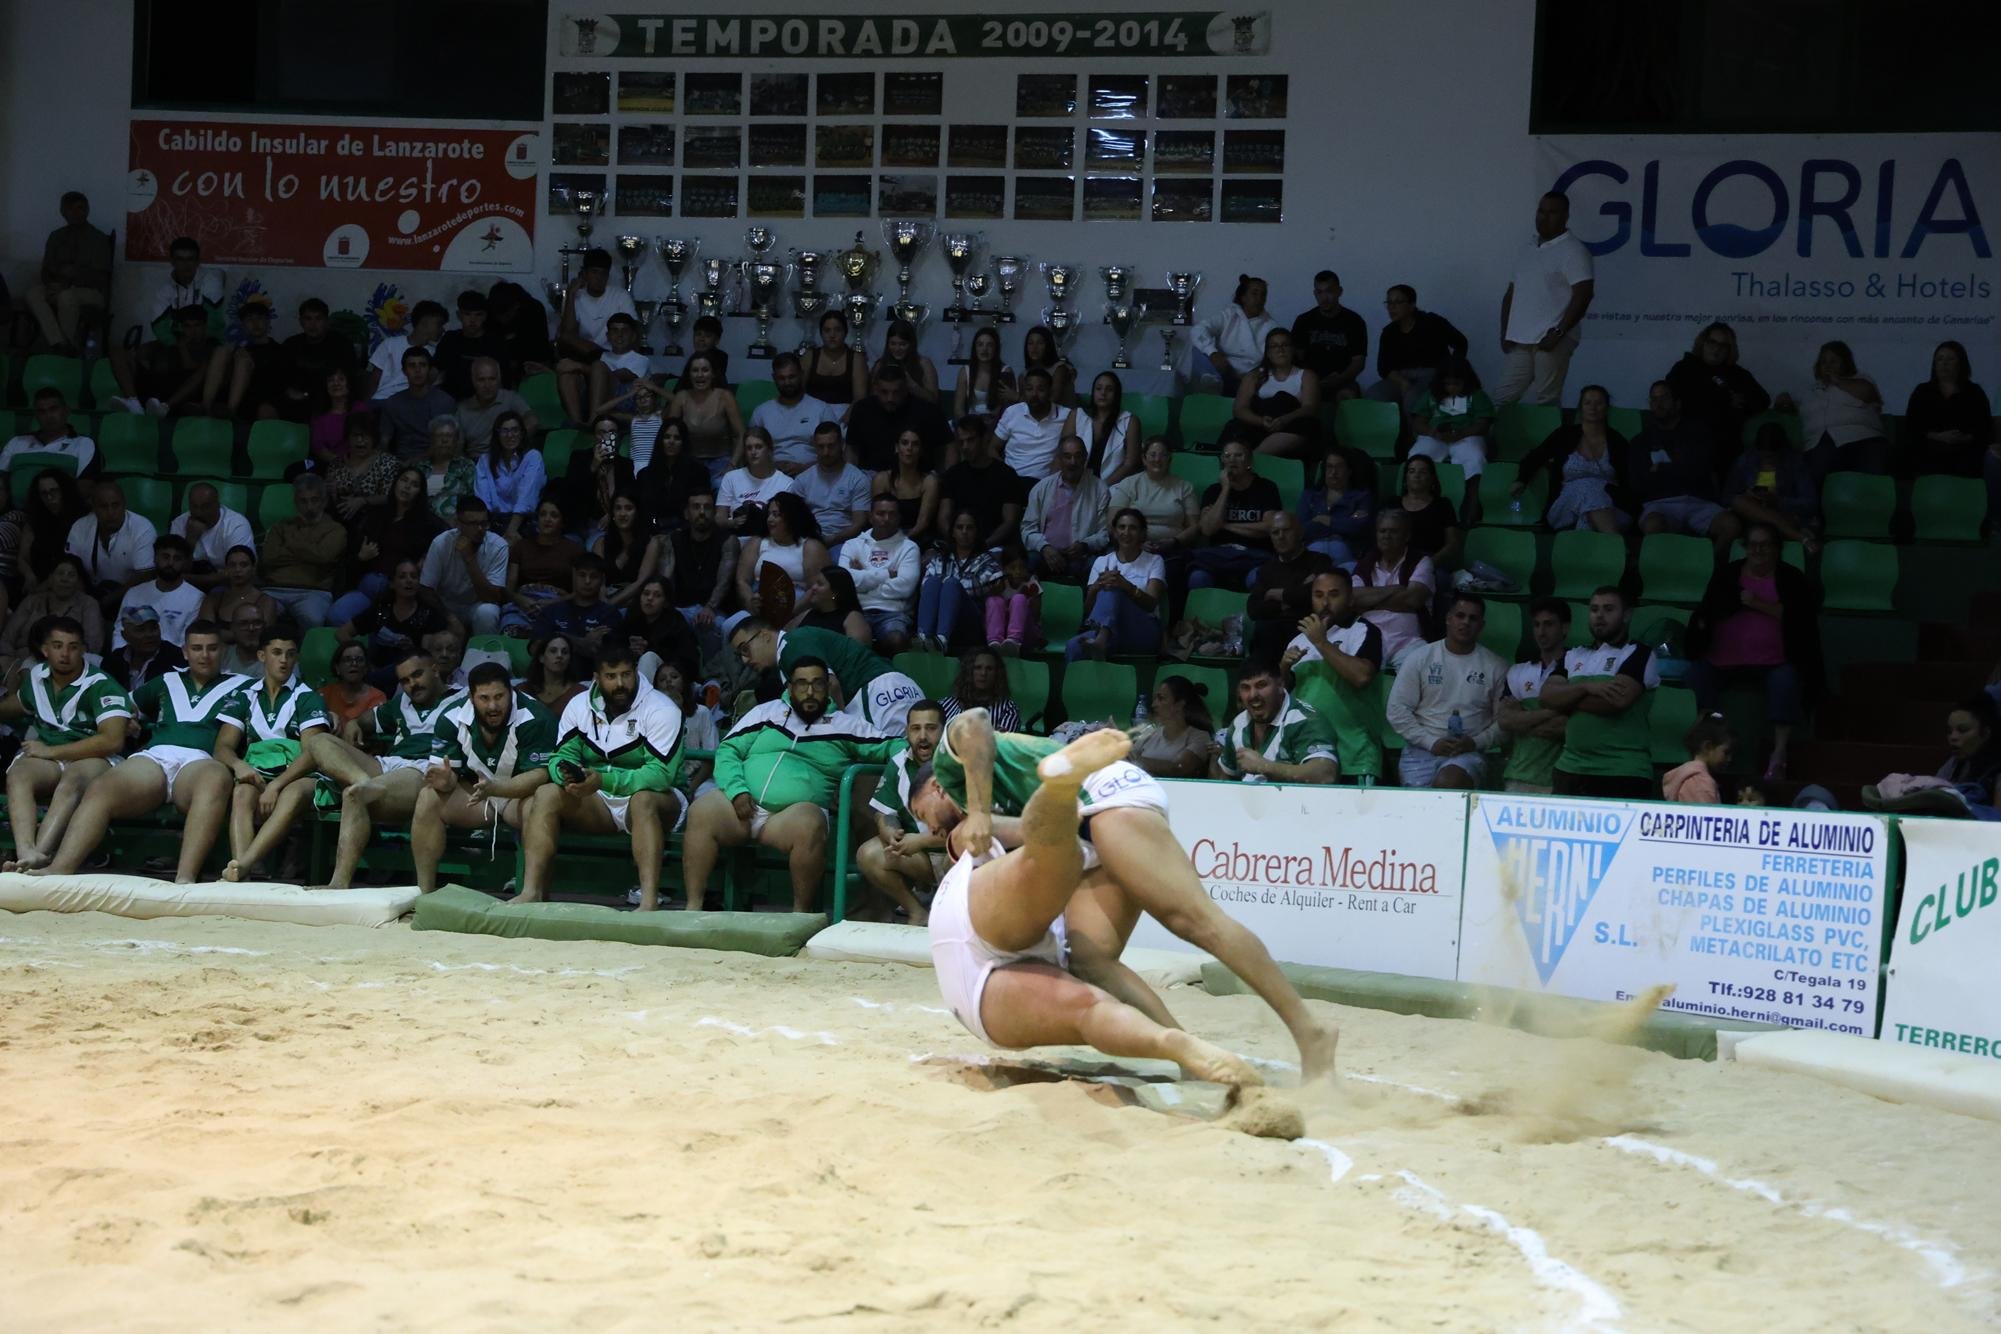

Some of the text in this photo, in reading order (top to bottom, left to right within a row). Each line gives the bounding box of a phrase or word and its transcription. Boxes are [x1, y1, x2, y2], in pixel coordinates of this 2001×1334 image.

[637, 18, 1189, 55] TEMPORADA 2009-2014
[158, 128, 485, 159] Cabildo Insular de Lanzarote
[172, 156, 481, 204] con lo nuestro
[388, 202, 525, 246] www.lanzarotedeportes.com
[1552, 158, 1992, 258] GLORIA
[1732, 271, 1991, 299] Thalasso & Hotels
[876, 686, 922, 707] GLORIA
[1497, 806, 1621, 836] ALUMINIO
[1640, 811, 1874, 854] CARPINTERIA DE ALUMINIO
[1191, 838, 1439, 894] Cabrera Medina
[1762, 853, 1874, 879] FERRETERIA
[1210, 884, 1257, 904] Coches
[1261, 888, 1276, 905] de
[1280, 889, 1335, 911] Alquiler
[1348, 894, 1378, 912] Rent
[1381, 901, 1389, 912] a
[1393, 896, 1417, 915] Car
[1652, 866, 1873, 903] PERFILES DE ALUMINIO
[1910, 857, 1999, 945] CLUB
[1658, 887, 1872, 927] CHAPAS DE ALUMINIO
[1595, 921, 1639, 948] S.L.
[1700, 914, 1870, 951] PLEXIGLASS PVC,
[1690, 935, 1822, 967] METACRILATO
[1774, 968, 1867, 991] C/Tegala 19
[1708, 981, 1865, 1014] Tlf.:928 81 34 79
